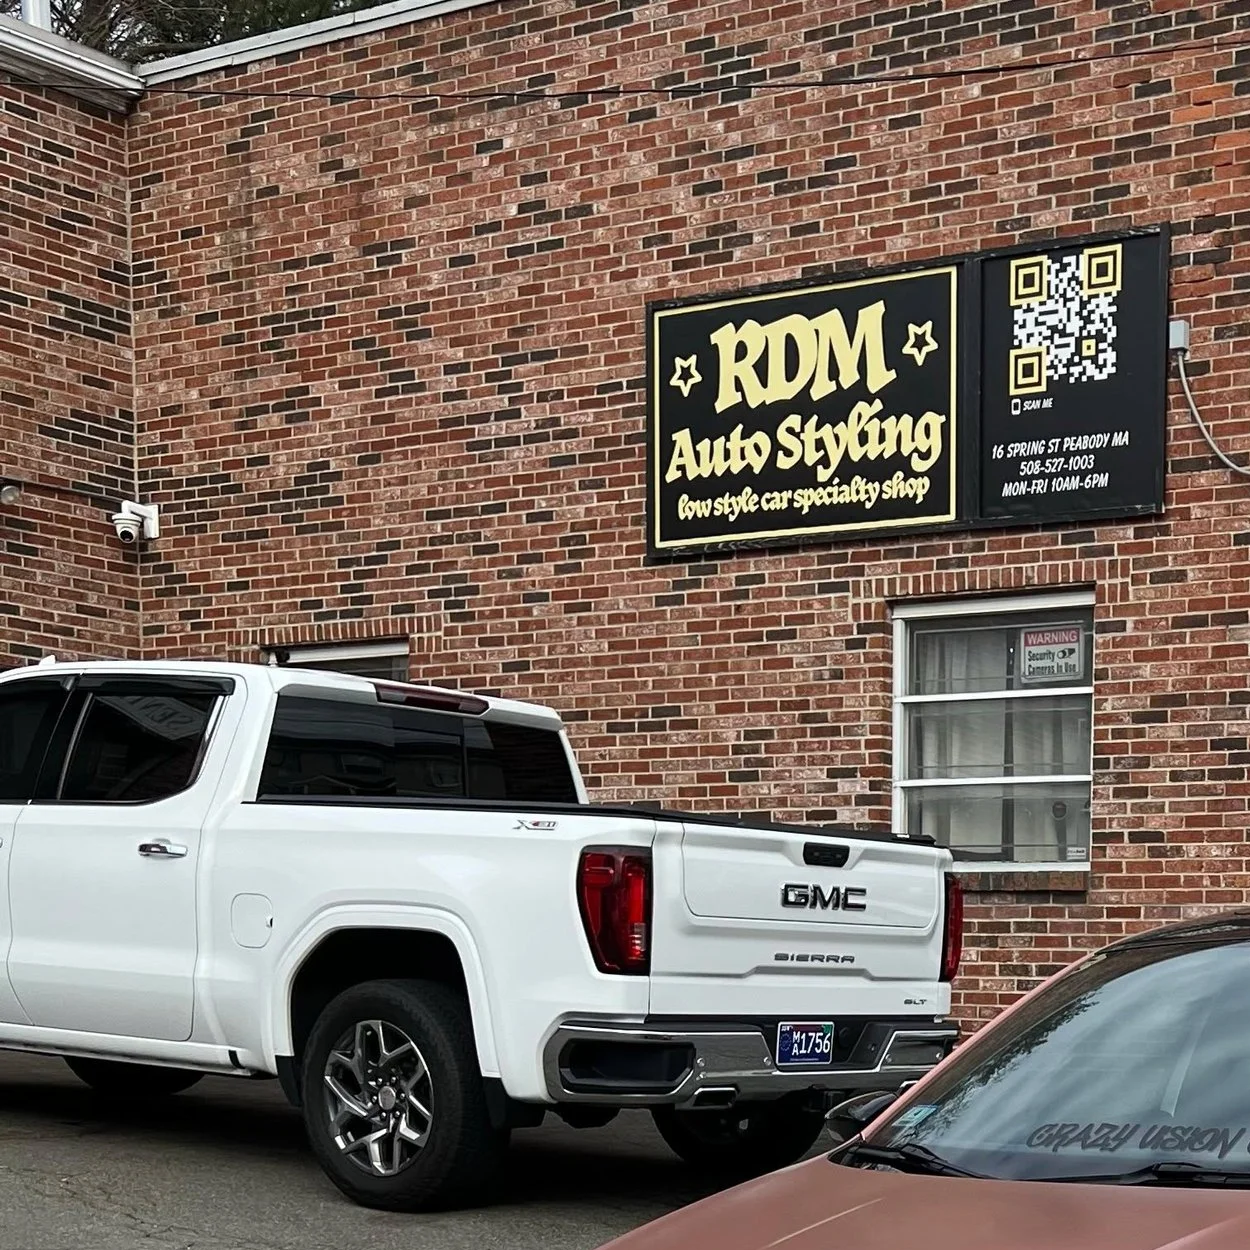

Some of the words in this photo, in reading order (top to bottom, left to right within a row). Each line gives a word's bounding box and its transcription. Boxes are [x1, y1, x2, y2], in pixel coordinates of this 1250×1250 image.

[710, 300, 897, 415] RDM
[1022, 400, 1042, 412] SCAN
[1041, 397, 1054, 409] ME
[665, 424, 772, 484] Auto
[775, 398, 947, 483] Styling
[992, 444, 1005, 460] 16
[1006, 439, 1046, 459] SPRING
[1047, 438, 1062, 454] ST
[1062, 432, 1111, 452] PEABODY
[1110, 430, 1130, 447] MA
[1019, 454, 1095, 476] 508-527-1003
[1001, 478, 1049, 498] MON-FRI
[1051, 471, 1110, 493] 10AM-6PM
[677, 493, 713, 521] low
[713, 486, 760, 522] style
[760, 489, 793, 511] car
[793, 474, 881, 515] specialty
[881, 470, 931, 505] shop
[1026, 630, 1078, 645] WARNING
[1027, 649, 1056, 662] Security
[1027, 663, 1056, 675] Cameras
[1056, 662, 1063, 673] In
[1064, 661, 1077, 673] Use
[781, 883, 867, 911] GMC
[774, 953, 855, 964] SIERRA
[800, 1032, 831, 1054] 1756
